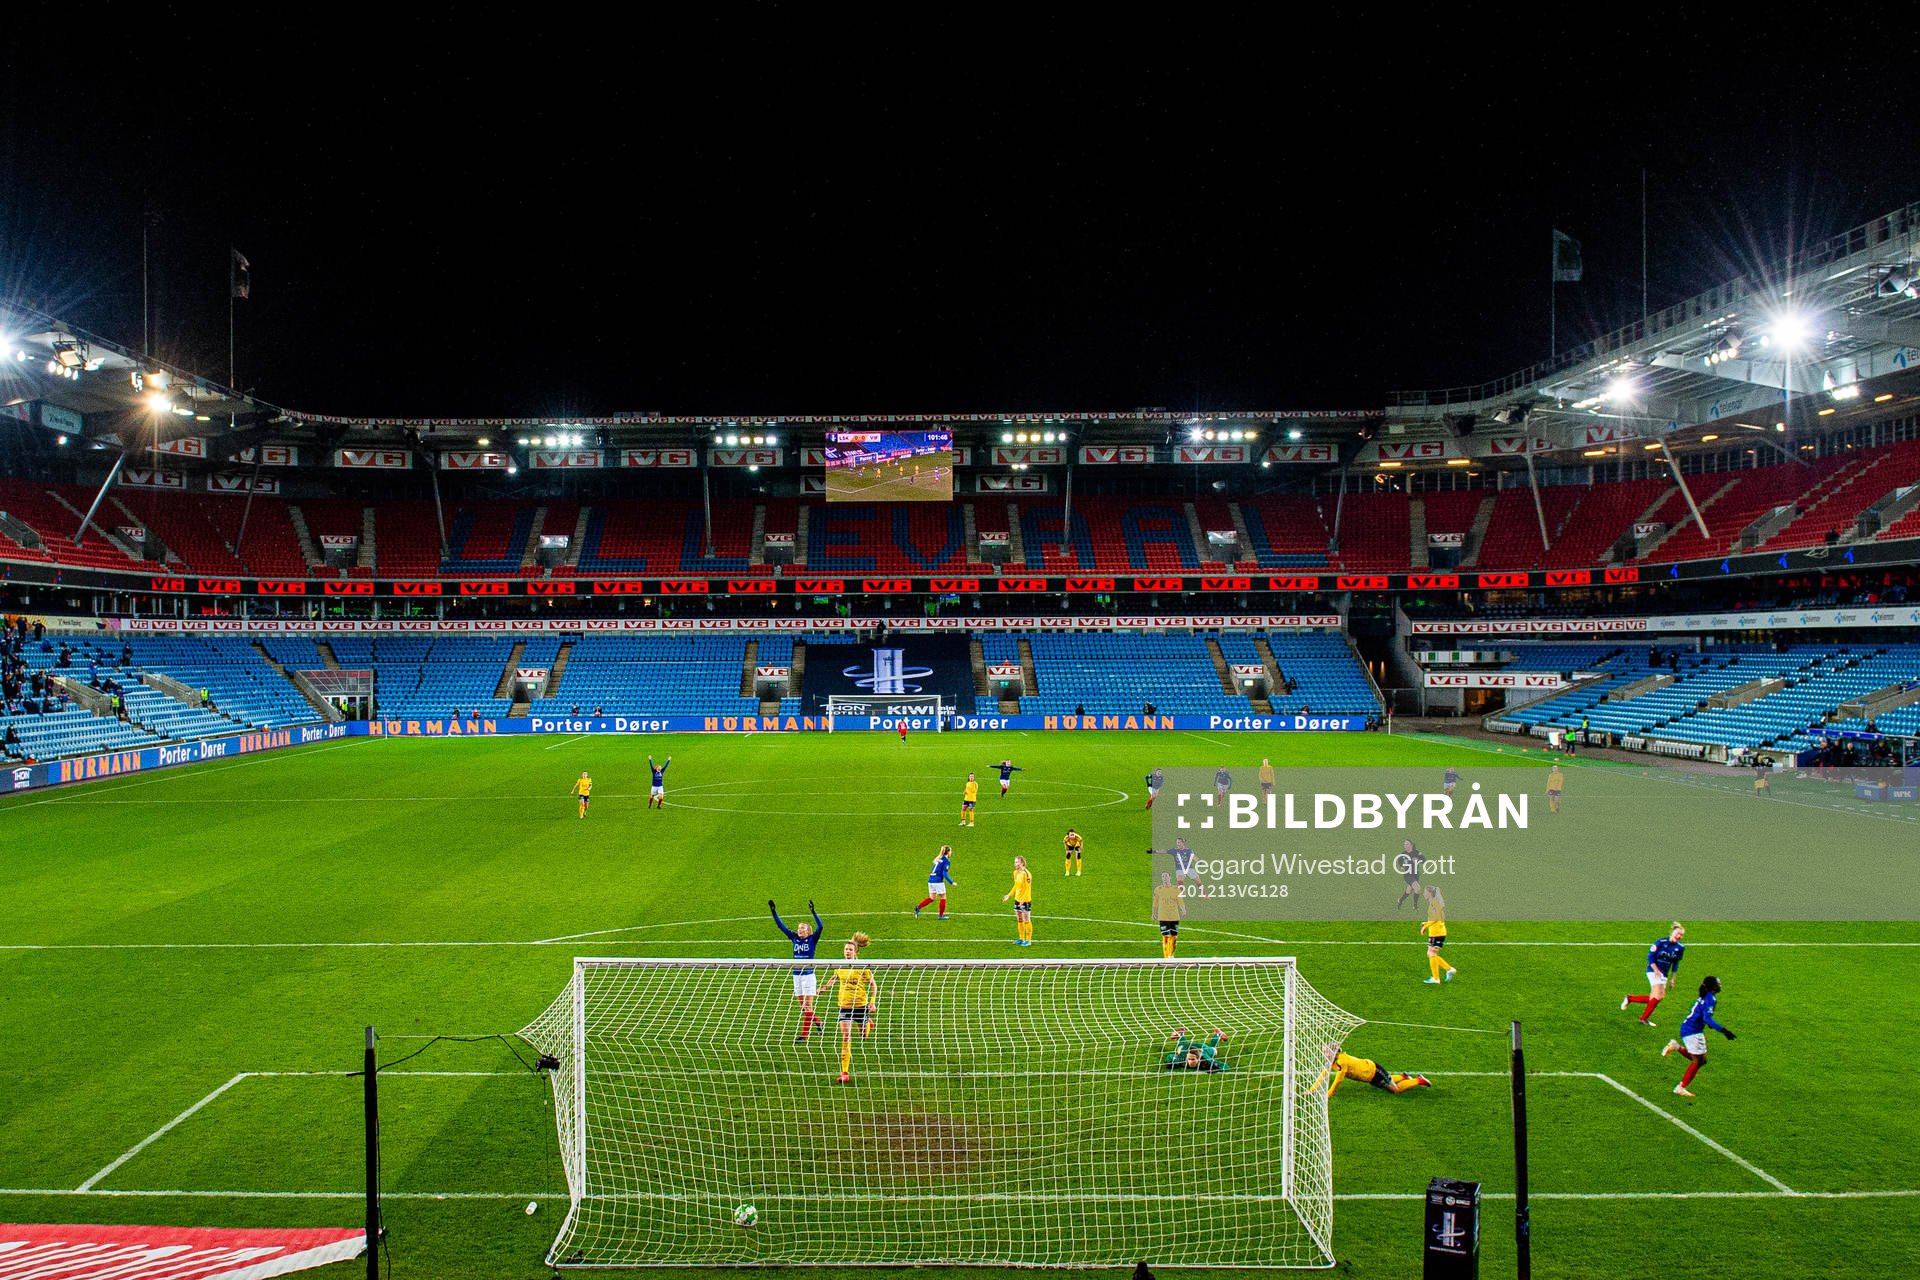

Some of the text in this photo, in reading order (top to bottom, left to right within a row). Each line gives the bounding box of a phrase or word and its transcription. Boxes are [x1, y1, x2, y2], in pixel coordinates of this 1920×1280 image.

[714, 449, 776, 465] VG
[996, 447, 1060, 463] VG
[1085, 447, 1147, 463] VG
[1181, 447, 1243, 462] VG
[1268, 445, 1332, 461] VG
[1380, 441, 1444, 459] VG
[343, 451, 405, 466] VG
[449, 453, 508, 468] VG
[537, 452, 599, 467] VG
[629, 450, 690, 466] VG
[125, 471, 182, 486] VG
[216, 475, 276, 491] VG
[981, 475, 1040, 491] VG
[324, 535, 353, 544] VG
[768, 534, 793, 542] VG
[982, 532, 1008, 540] VG
[1431, 534, 1463, 543] VG
[154, 569, 1636, 593] VG VG VG VG VG VG VG VG VG VG VG VG VG VG VG VG VG VG VG VG VG VG VG
[132, 620, 148, 629] VG
[153, 621, 177, 629] VG
[183, 621, 208, 630] VG
[215, 621, 242, 630] VG
[249, 621, 279, 630] VG
[286, 621, 316, 630] VG
[324, 621, 354, 630] VG
[363, 621, 392, 630] VG
[401, 621, 431, 630] VG
[439, 621, 469, 630] VG
[476, 621, 506, 630] VG
[513, 621, 543, 629] VG
[550, 620, 581, 629] VG
[588, 620, 618, 629] VG
[626, 620, 656, 629] VG
[663, 620, 694, 628] VG
[700, 620, 731, 628] VG
[738, 619, 769, 628] VG
[776, 619, 807, 628] VG
[814, 619, 844, 628] VG
[889, 619, 920, 627] VG
[927, 619, 958, 627] VG
[965, 619, 996, 627] VG
[1003, 618, 1034, 627] VG
[1041, 618, 1072, 627] VG
[1079, 618, 1110, 627] VG
[1117, 618, 1148, 626] VG
[1155, 618, 1186, 626] VG
[1193, 617, 1224, 626] VG
[1231, 617, 1262, 626] VG
[1269, 617, 1300, 626] VG
[1307, 617, 1338, 625] VG
[1414, 620, 1646, 633] VG VG VG VG VG VG VG
[517, 669, 547, 678] VG
[757, 668, 788, 676] VG
[990, 667, 1020, 675] VG
[1234, 666, 1264, 675] VG
[1430, 676, 1558, 686] VG VG VG
[887, 705, 934, 715] KIWI
[369, 715, 1350, 735] HÖRMANN Porter Dører HÖRMANN Porter Dører HÖRMANN Porter Dører
[60, 724, 347, 782] HÖRMANN Porter Dører HÖRMANN Porter Dører
[793, 943, 810, 954] DNB
